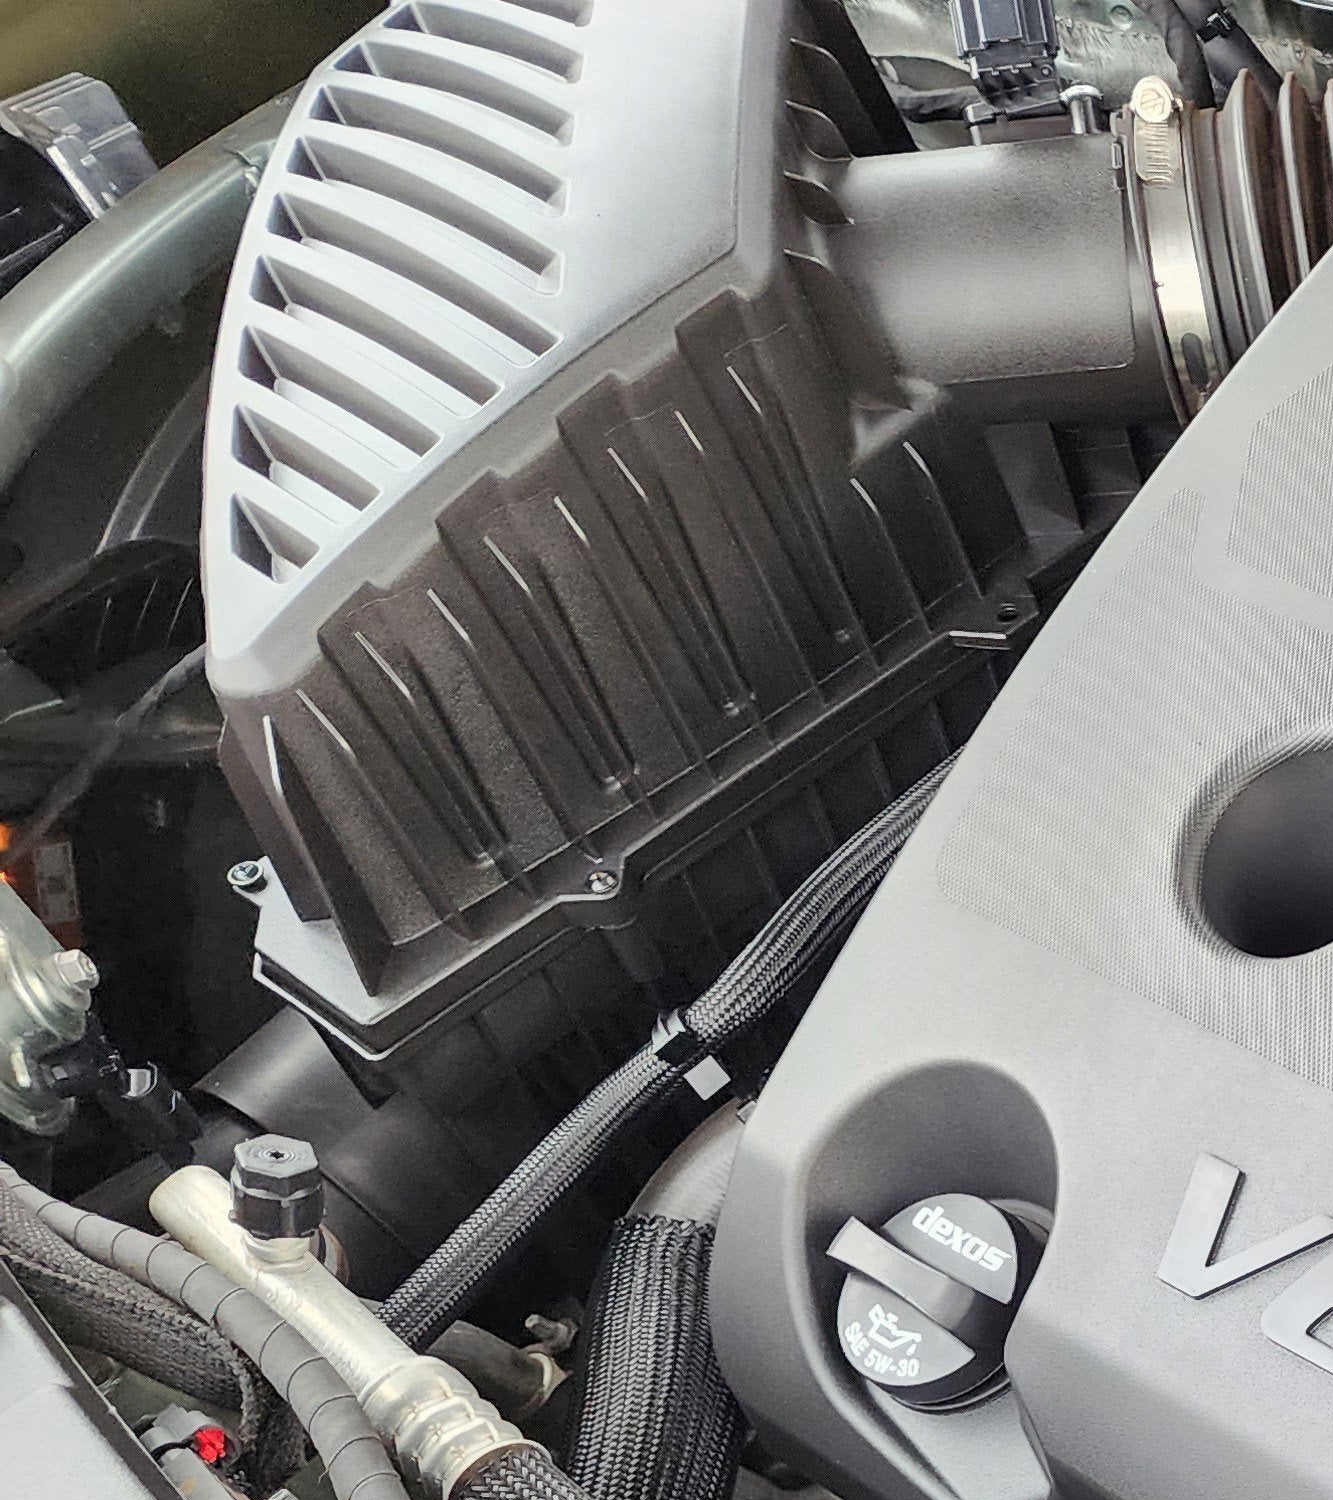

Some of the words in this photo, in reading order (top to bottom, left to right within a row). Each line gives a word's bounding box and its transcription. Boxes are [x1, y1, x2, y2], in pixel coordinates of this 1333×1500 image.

[911, 1205, 1013, 1272] dexos
[844, 1321, 869, 1358] SAE
[864, 1351, 921, 1378] 5W-30
